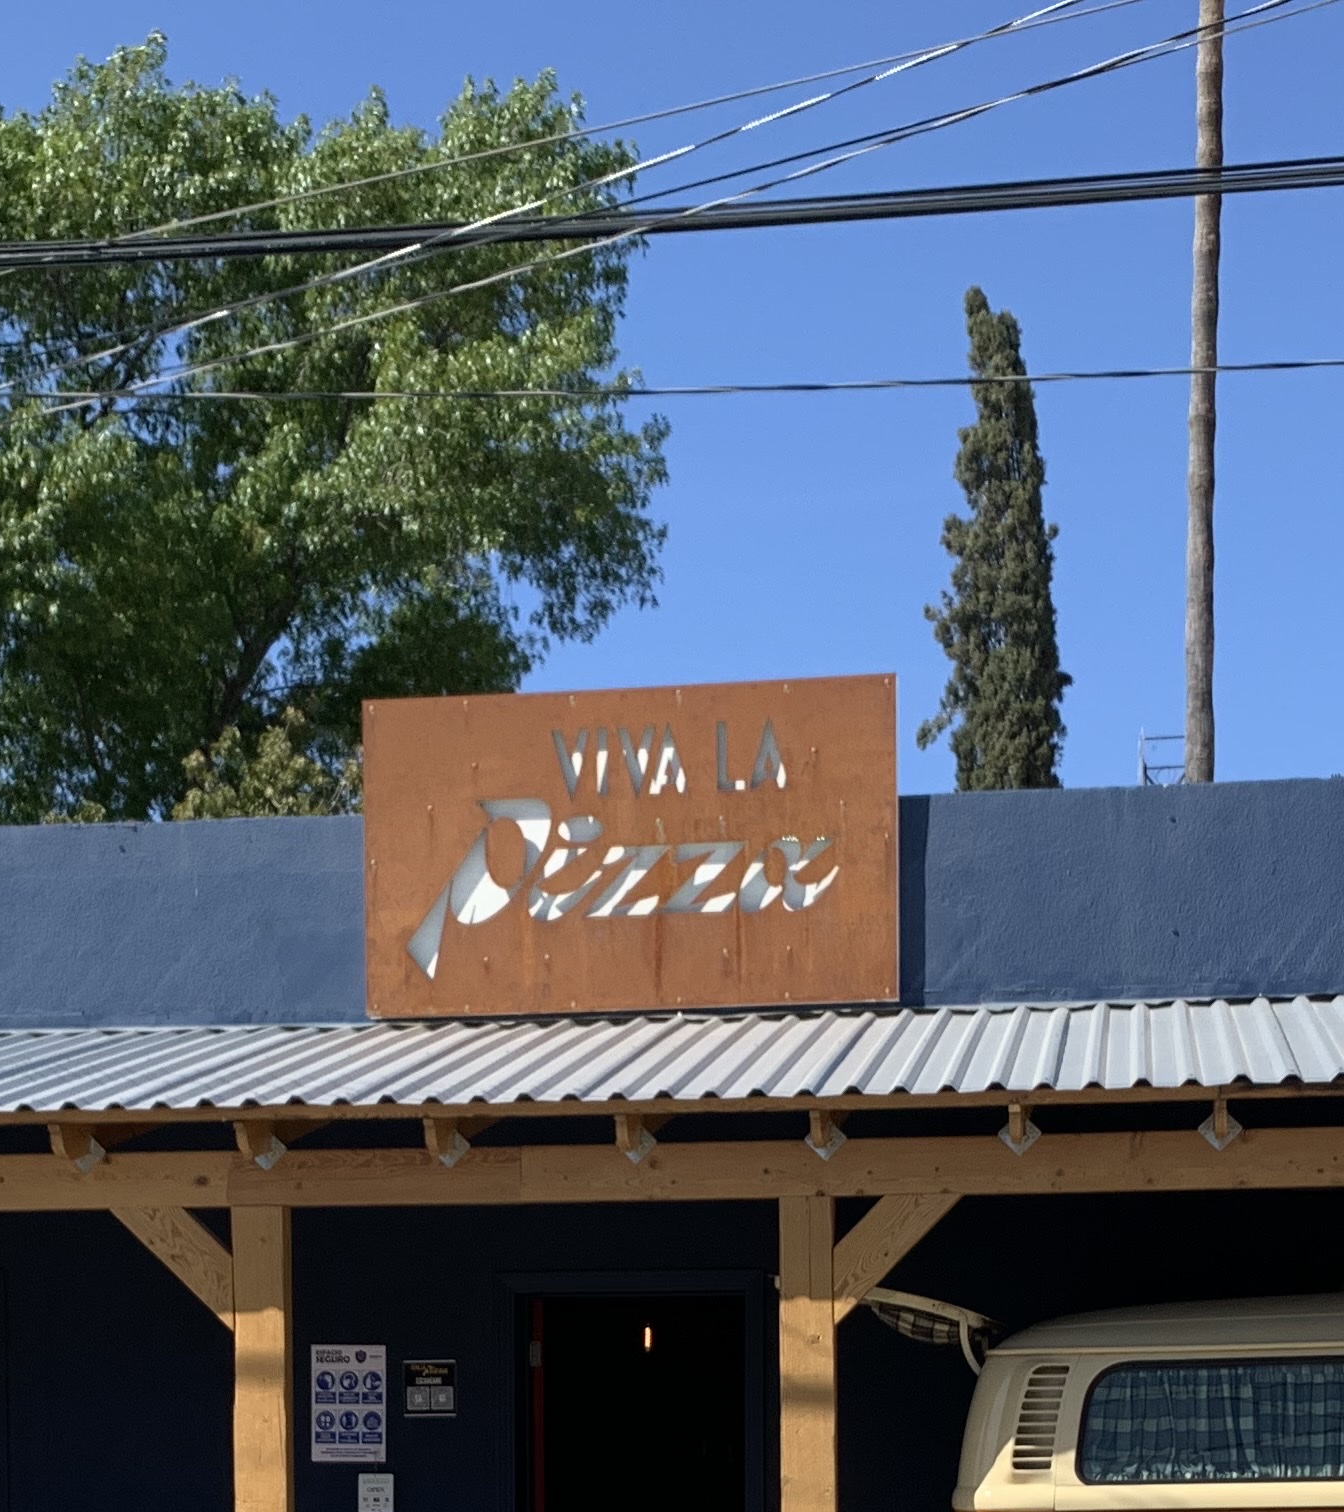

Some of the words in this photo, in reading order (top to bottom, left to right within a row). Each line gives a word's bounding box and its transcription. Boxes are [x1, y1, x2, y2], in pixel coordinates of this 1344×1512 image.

[551, 722, 688, 800] VIVA
[715, 717, 788, 792] LA
[406, 797, 841, 982] Pizza
[315, 1355, 351, 1364] SEGURO
